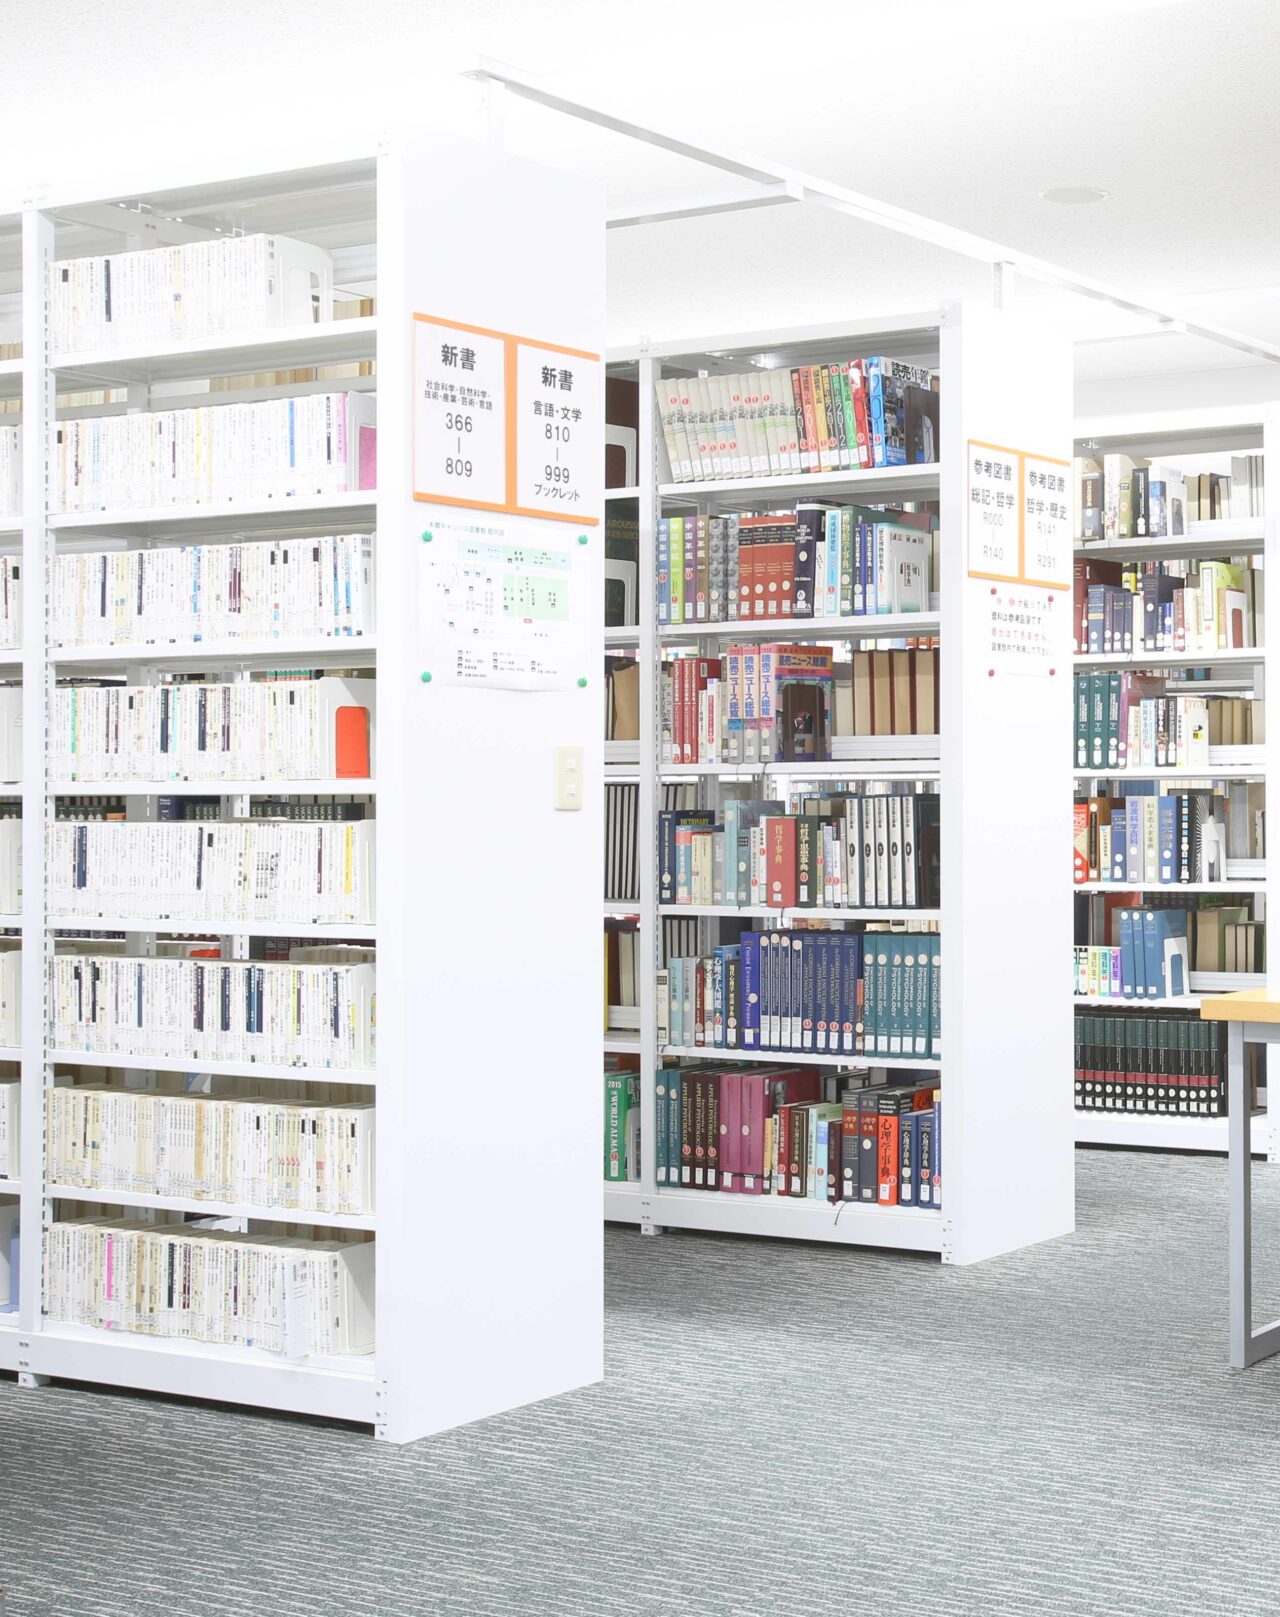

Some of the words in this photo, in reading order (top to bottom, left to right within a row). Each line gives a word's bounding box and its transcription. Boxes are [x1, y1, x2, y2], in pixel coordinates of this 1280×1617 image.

[441, 343, 477, 371] 新書
[541, 365, 573, 392] 新書
[891, 361, 930, 384] 読売年鑑
[533, 400, 582, 422] 言語・文学
[446, 413, 473, 432] 366
[545, 423, 570, 442] 810
[445, 458, 473, 477] 809
[545, 465, 570, 484] 999
[973, 458, 1012, 481] 参考図書
[534, 483, 580, 502] ブックレット
[1029, 471, 1065, 493] 参考図書
[971, 487, 1015, 510] 総記・哲学
[1026, 497, 1068, 521] 哲学・歴史
[983, 511, 1003, 527] R000
[983, 547, 1003, 561] R140
[1037, 554, 1056, 569] R291
[774, 825, 783, 864] 哲学事典
[881, 1119, 892, 1178] 心理学事典
